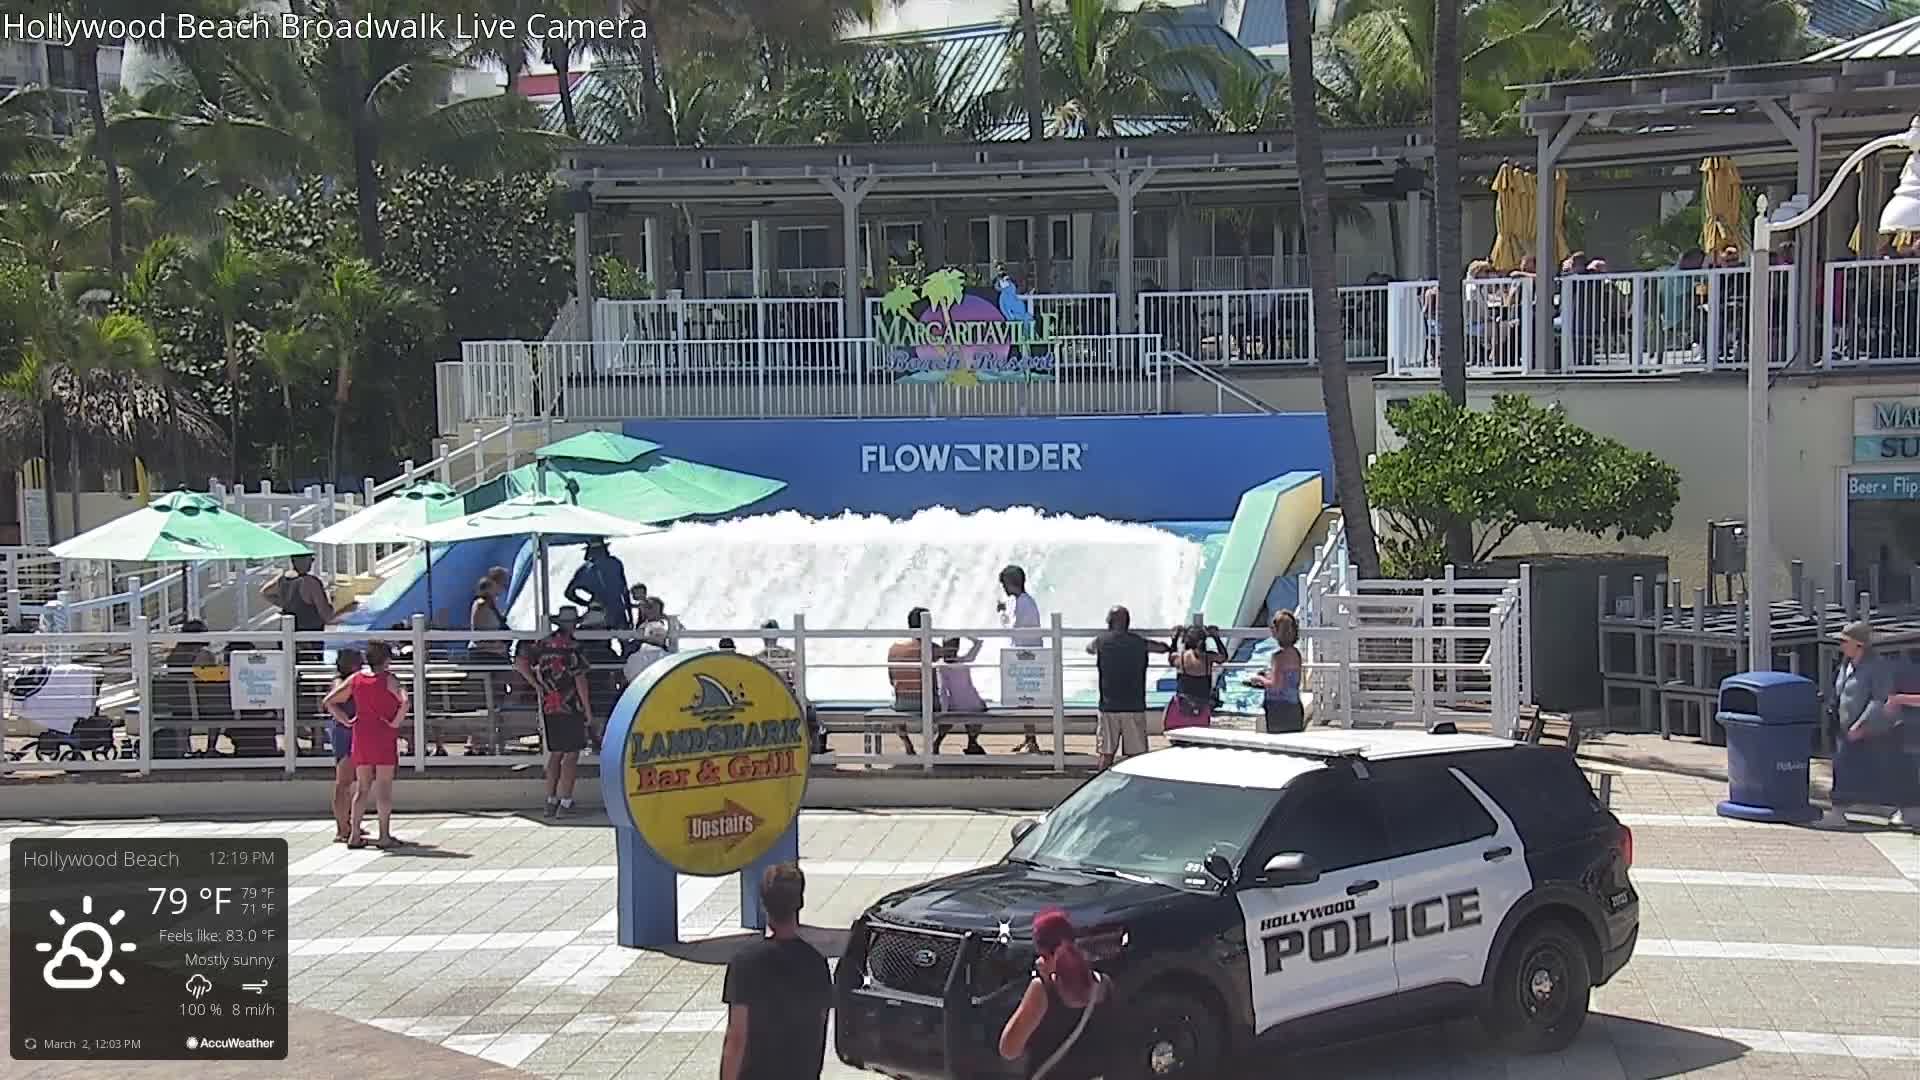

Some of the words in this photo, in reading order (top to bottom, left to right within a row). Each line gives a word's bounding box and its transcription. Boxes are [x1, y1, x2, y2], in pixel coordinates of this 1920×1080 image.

[1850, 479, 1878, 493] Beer
[632, 719, 802, 761] LANDSHARK
[637, 768, 690, 792] Bar
[696, 760, 720, 785] &
[727, 751, 797, 780] Grill
[691, 815, 753, 839] Upstairs
[1261, 899, 1356, 931] HOLLYWOOD
[1261, 888, 1483, 976] POLICE
